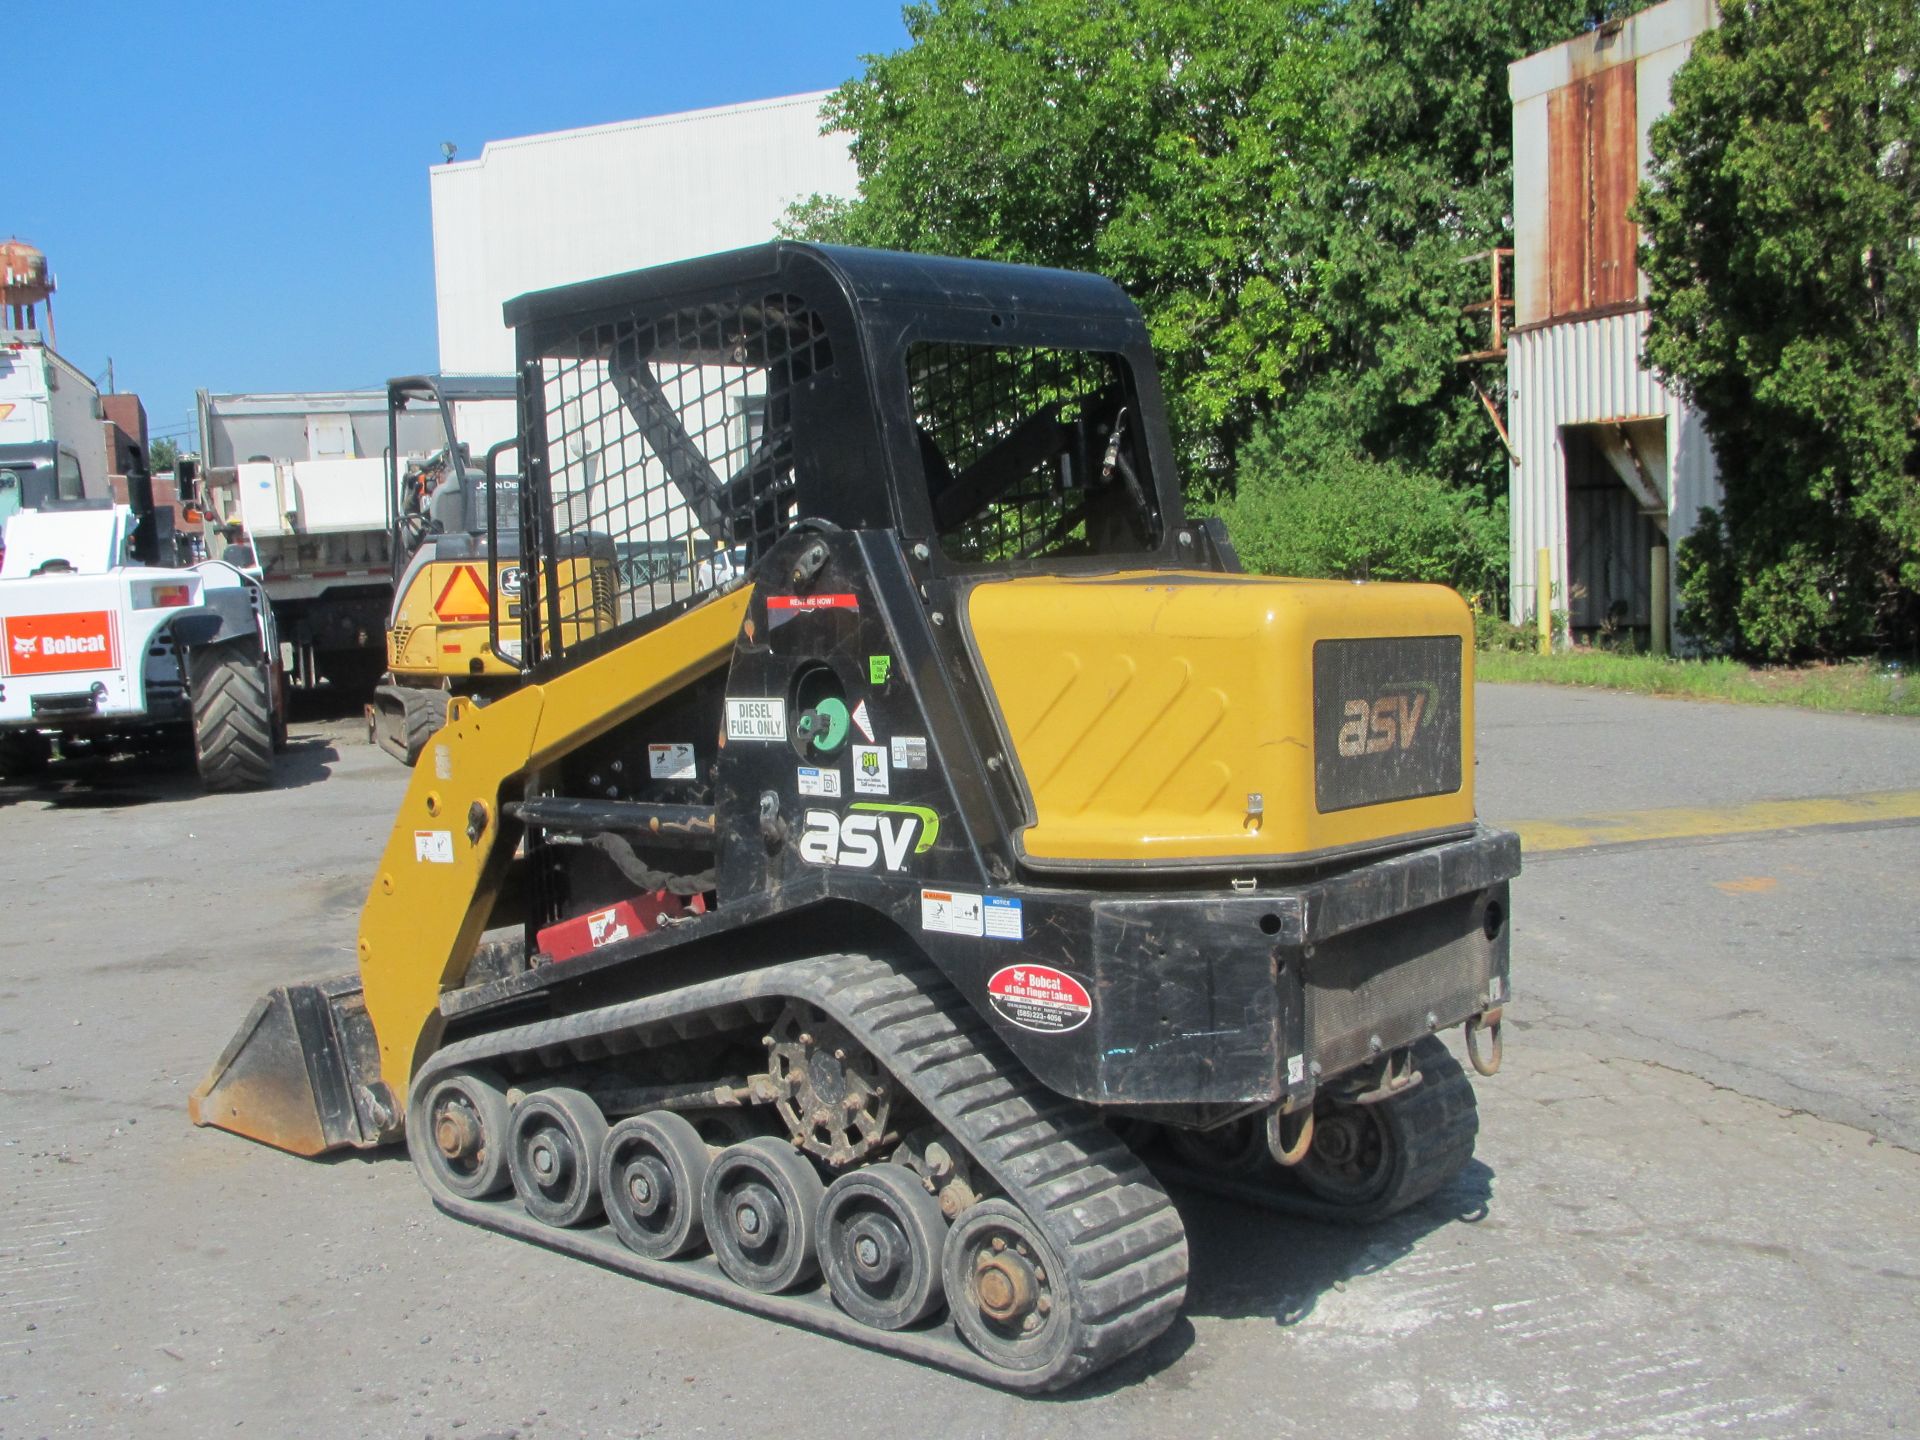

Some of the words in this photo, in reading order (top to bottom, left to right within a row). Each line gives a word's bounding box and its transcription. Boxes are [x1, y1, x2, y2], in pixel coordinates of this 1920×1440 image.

[476, 481, 502, 489] JON
[42, 634, 107, 656] Bobcat
[739, 703, 772, 718] DIESEL
[731, 719, 755, 734] FUEL
[757, 719, 781, 735] ONLY
[1338, 691, 1425, 759] asv
[863, 752, 878, 768] 811
[800, 810, 917, 872] asv
[1029, 973, 1061, 990] Bobcat
[1004, 984, 1013, 993] of
[1013, 985, 1026, 995] the
[1026, 986, 1050, 999] Finger
[1051, 990, 1073, 1002] Lakes
